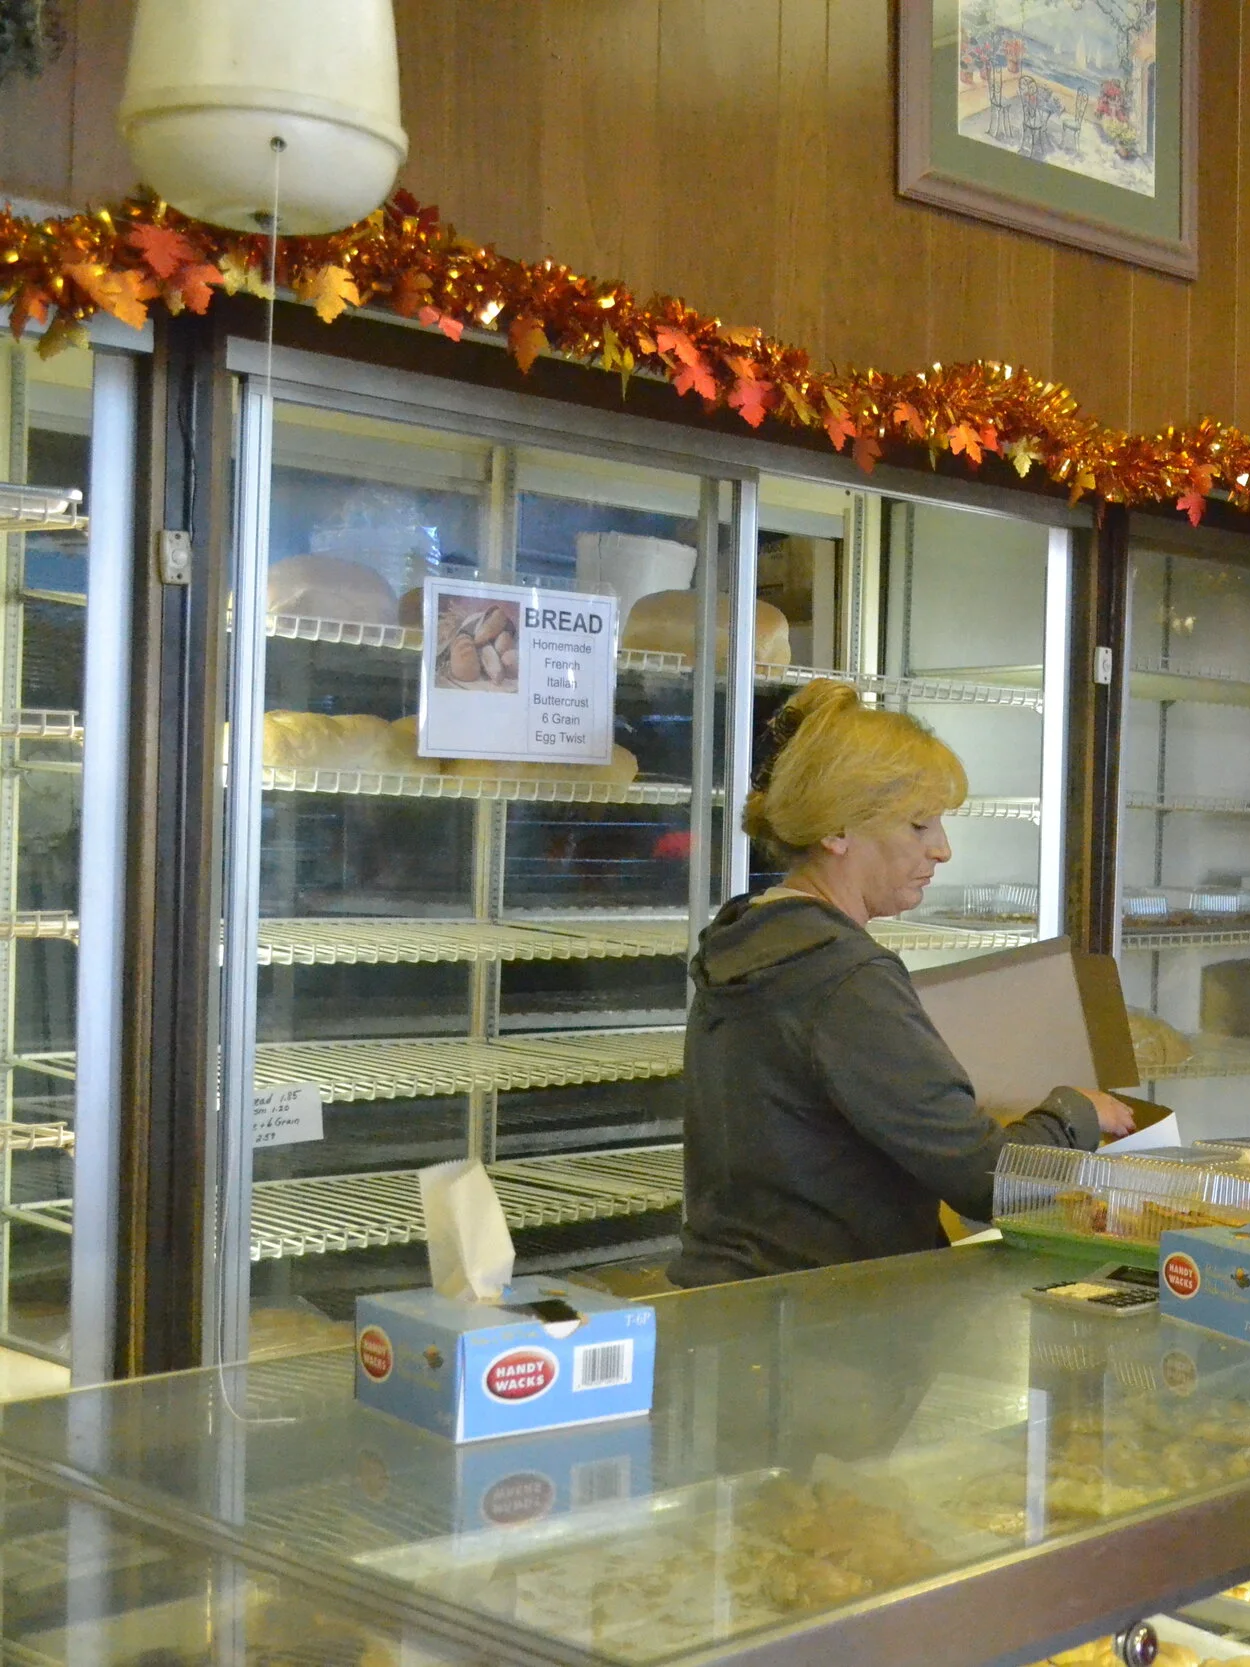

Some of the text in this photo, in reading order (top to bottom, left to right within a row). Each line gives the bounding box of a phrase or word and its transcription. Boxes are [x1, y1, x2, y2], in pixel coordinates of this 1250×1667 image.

[525, 607, 603, 634] BREAD
[533, 639, 592, 654] Homemade
[545, 658, 581, 671] French
[547, 676, 578, 689] Italian
[534, 693, 589, 708] Buttercrust
[542, 713, 580, 725] 6 Grain
[536, 730, 586, 745] Egg Twist
[1169, 1263, 1193, 1278] HANDY
[1168, 1274, 1193, 1289] WACKS
[496, 1361, 545, 1377] HANDY
[495, 1375, 545, 1392] WACKS
